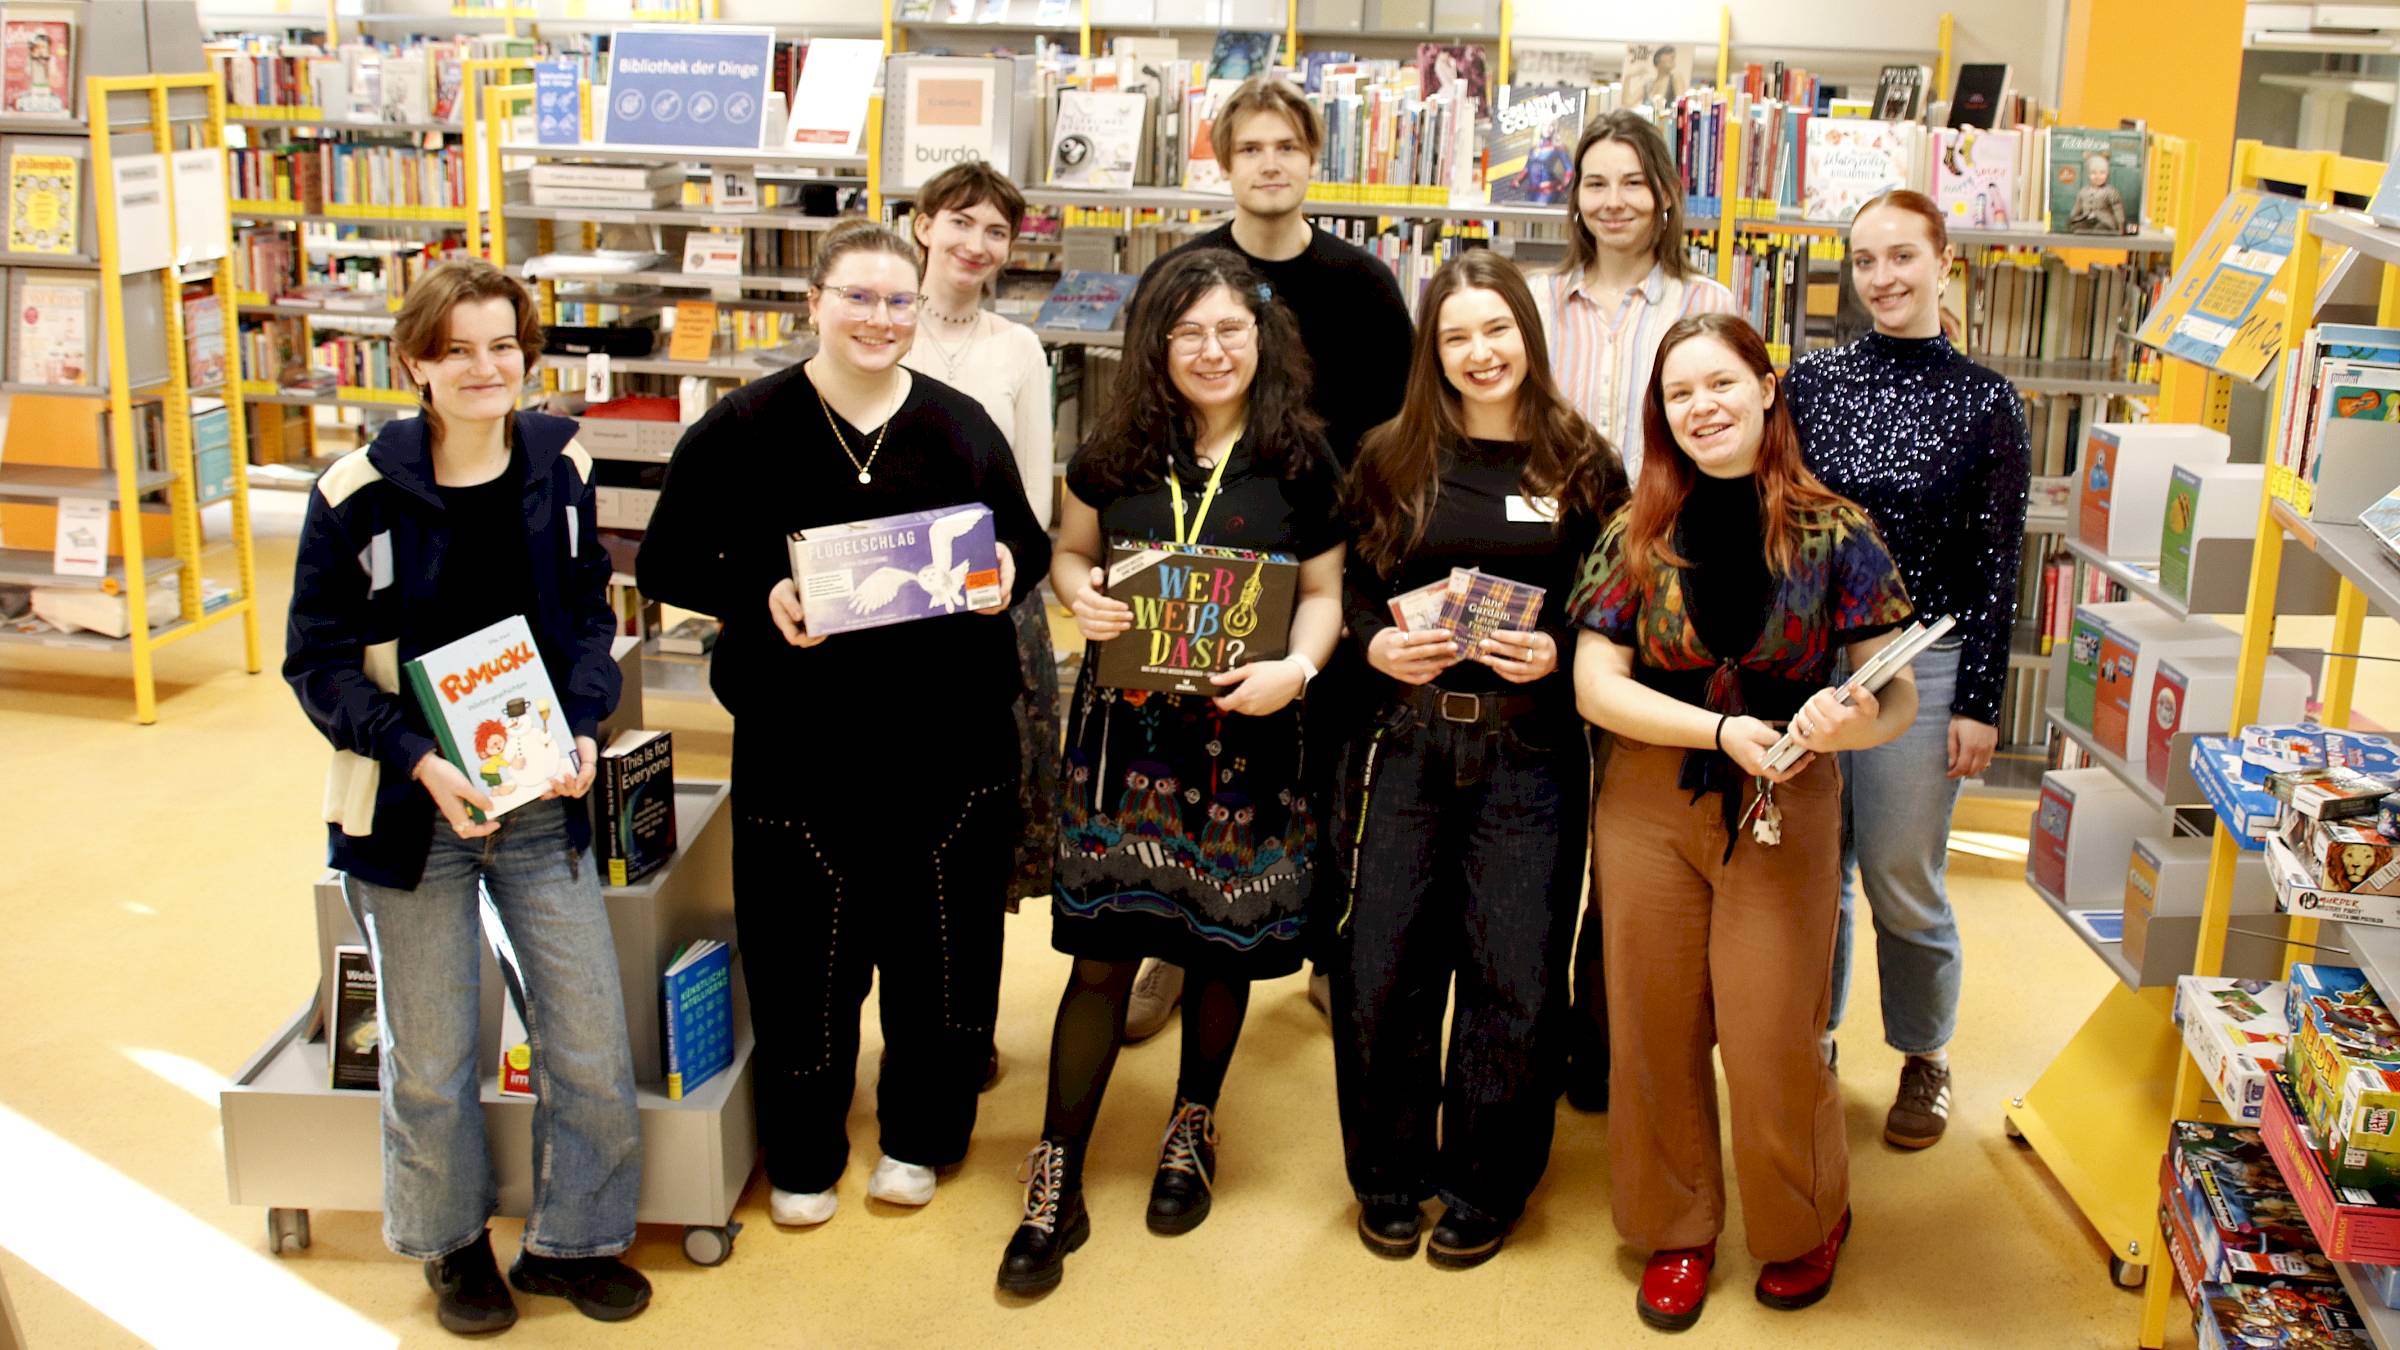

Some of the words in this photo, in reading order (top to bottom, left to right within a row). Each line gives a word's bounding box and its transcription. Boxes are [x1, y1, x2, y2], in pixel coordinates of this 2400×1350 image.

[619, 57, 688, 75] Bibliothek
[690, 60, 716, 75] der
[718, 61, 760, 79] Dinge
[915, 144, 981, 163] burda
[1157, 562, 1236, 606] WER
[1467, 603, 1511, 621] Gardam
[1481, 595, 1505, 609] Jane
[1148, 630, 1246, 674] DAS!?
[622, 752, 644, 772] This
[654, 740, 669, 757] for
[622, 755, 671, 789] Everyone
[680, 965, 728, 1002] KÜNSTLICHE
[680, 976, 729, 1013] INTELLIGENZ
